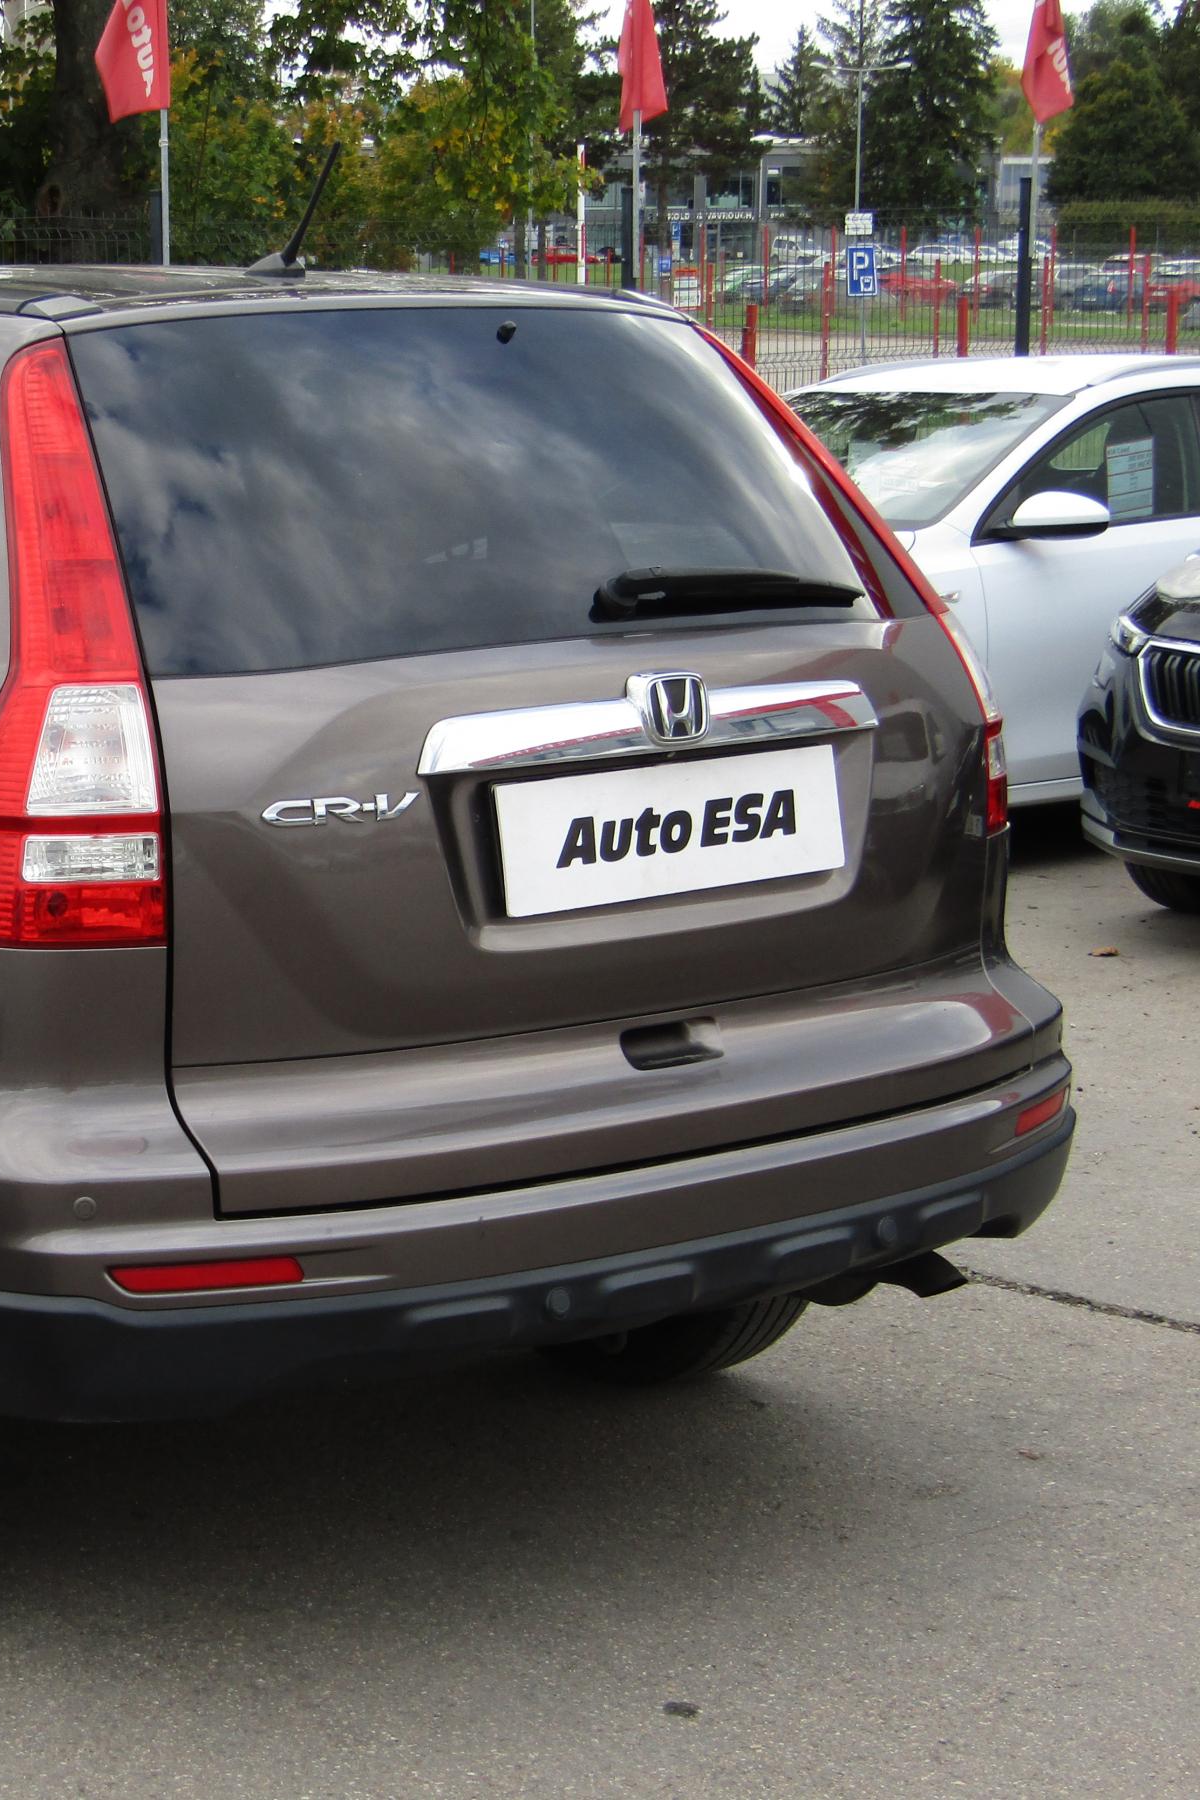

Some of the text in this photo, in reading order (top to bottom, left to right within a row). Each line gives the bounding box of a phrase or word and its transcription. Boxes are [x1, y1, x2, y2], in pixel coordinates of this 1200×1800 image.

[853, 251, 869, 281] P
[261, 791, 420, 827] CR-V
[556, 789, 796, 869] Auto ESA
